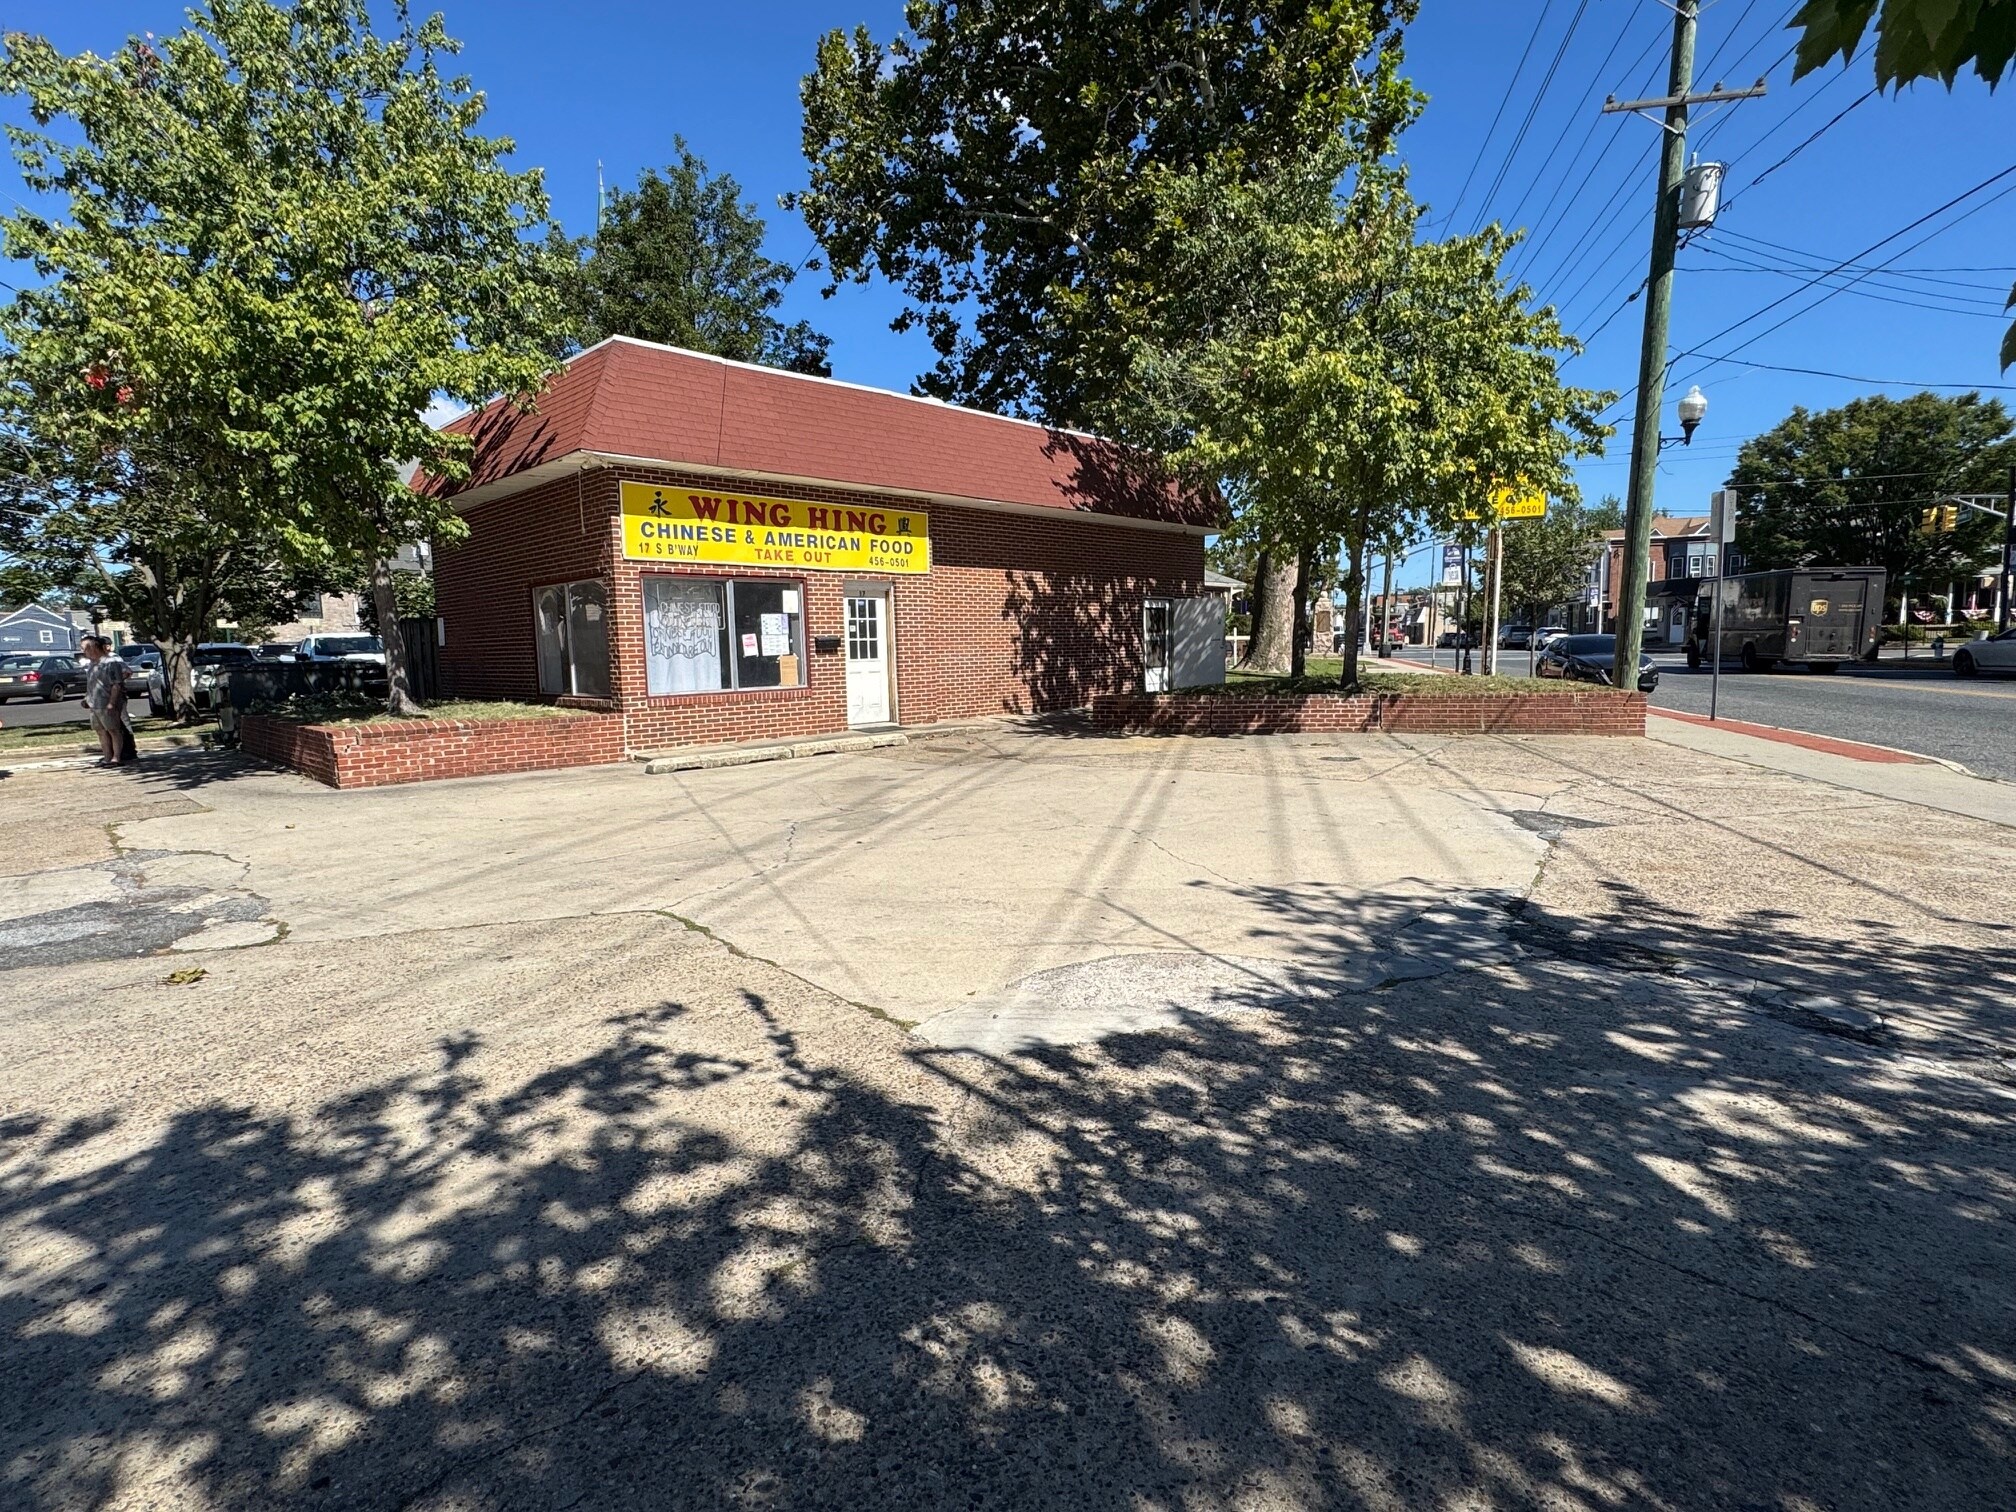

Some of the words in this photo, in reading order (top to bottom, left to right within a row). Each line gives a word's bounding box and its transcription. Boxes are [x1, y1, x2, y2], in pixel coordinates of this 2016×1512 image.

[649, 491, 672, 518] 永
[1499, 505, 1541, 516] 456-0501
[688, 495, 791, 527] WING
[807, 506, 887, 535] HING
[641, 521, 736, 543] CHINESE
[745, 529, 755, 545] &
[764, 530, 860, 552] AMERICAN
[870, 538, 913, 555] FOOD
[639, 542, 650, 554] 17
[656, 543, 662, 554] S
[668, 544, 699, 556] B'WAY
[755, 548, 794, 562] TAKE
[803, 550, 832, 563] OUT
[869, 556, 909, 568] 456-0501
